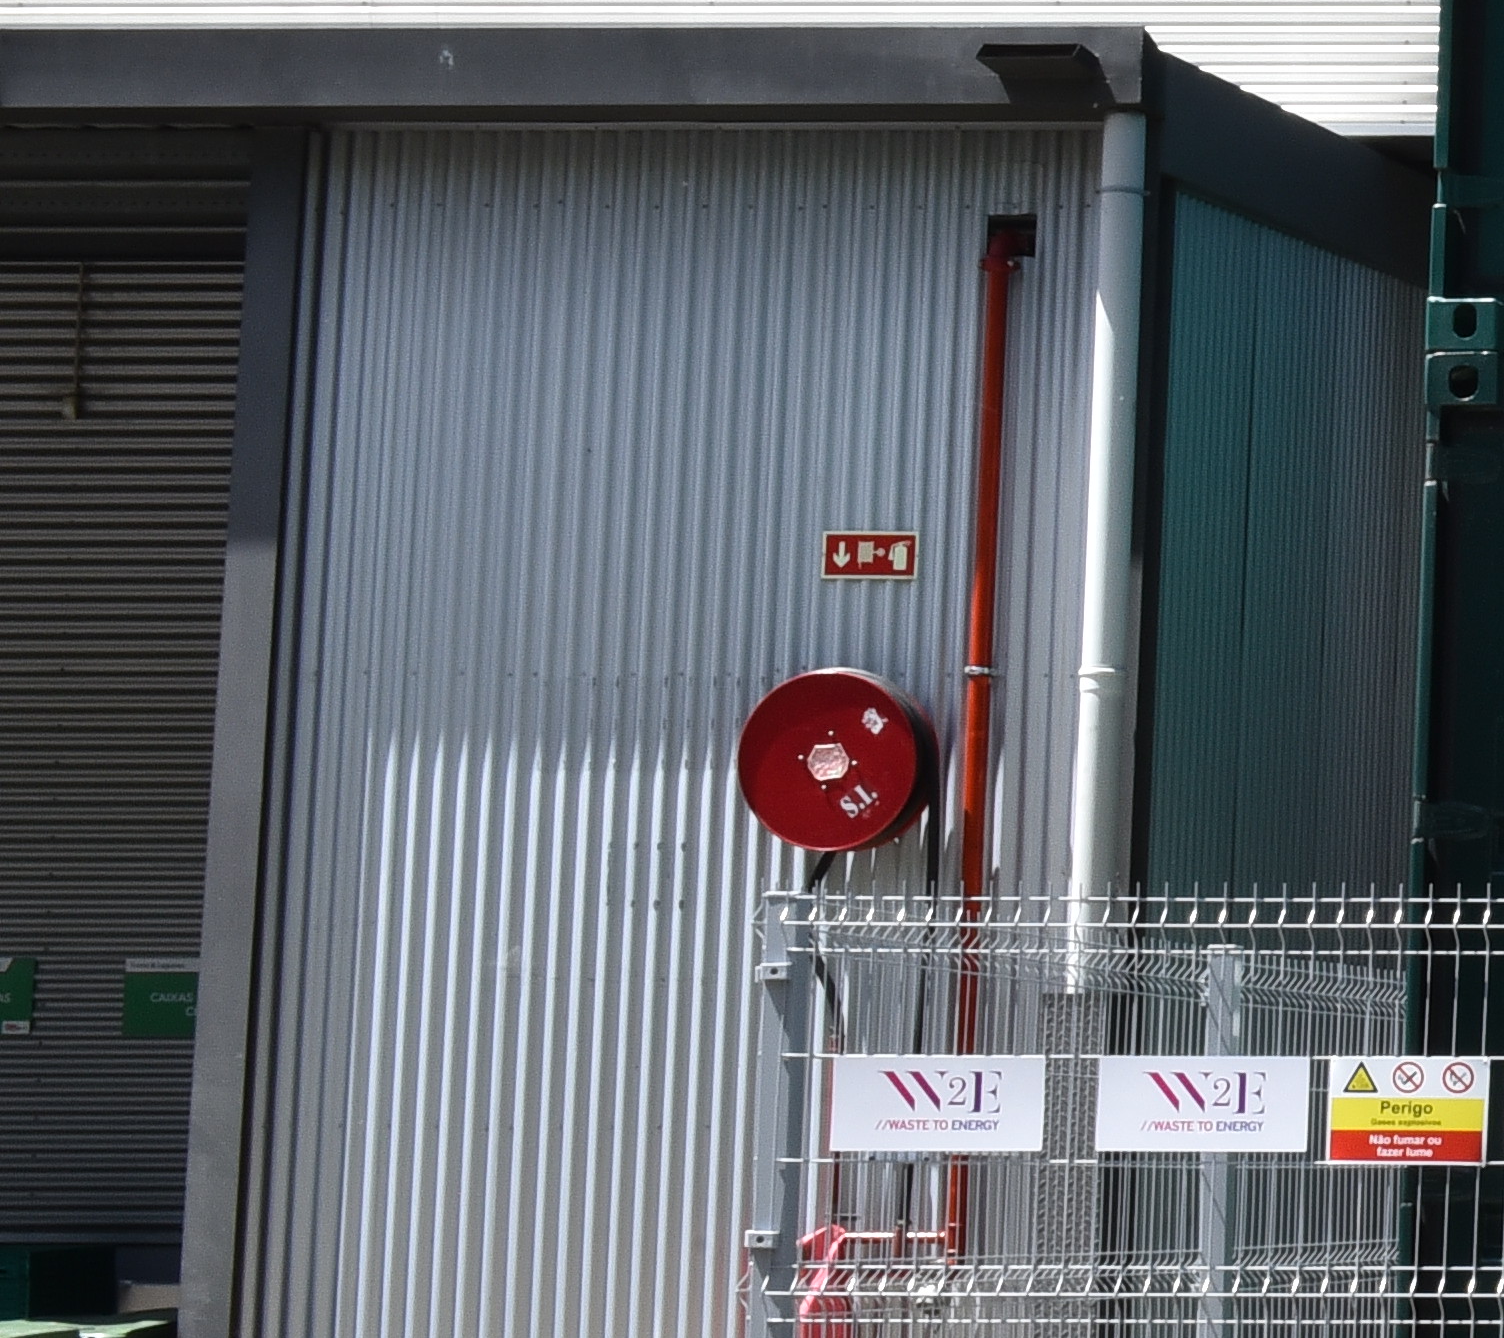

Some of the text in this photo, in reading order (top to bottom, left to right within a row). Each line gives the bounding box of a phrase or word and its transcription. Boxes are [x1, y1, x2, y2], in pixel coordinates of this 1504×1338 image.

[878, 1070, 1002, 1114] W2E
[1142, 1071, 1267, 1114] W2E
[1380, 1100, 1434, 1118] Perigo
[933, 1119, 949, 1131] TO
[951, 1119, 1000, 1131] ENERGY
[1198, 1121, 1214, 1132] TO
[1215, 1121, 1264, 1132] ENERGY
[1368, 1134, 1443, 1146] Não fumar ou
[1376, 1146, 1404, 1157] fazer
